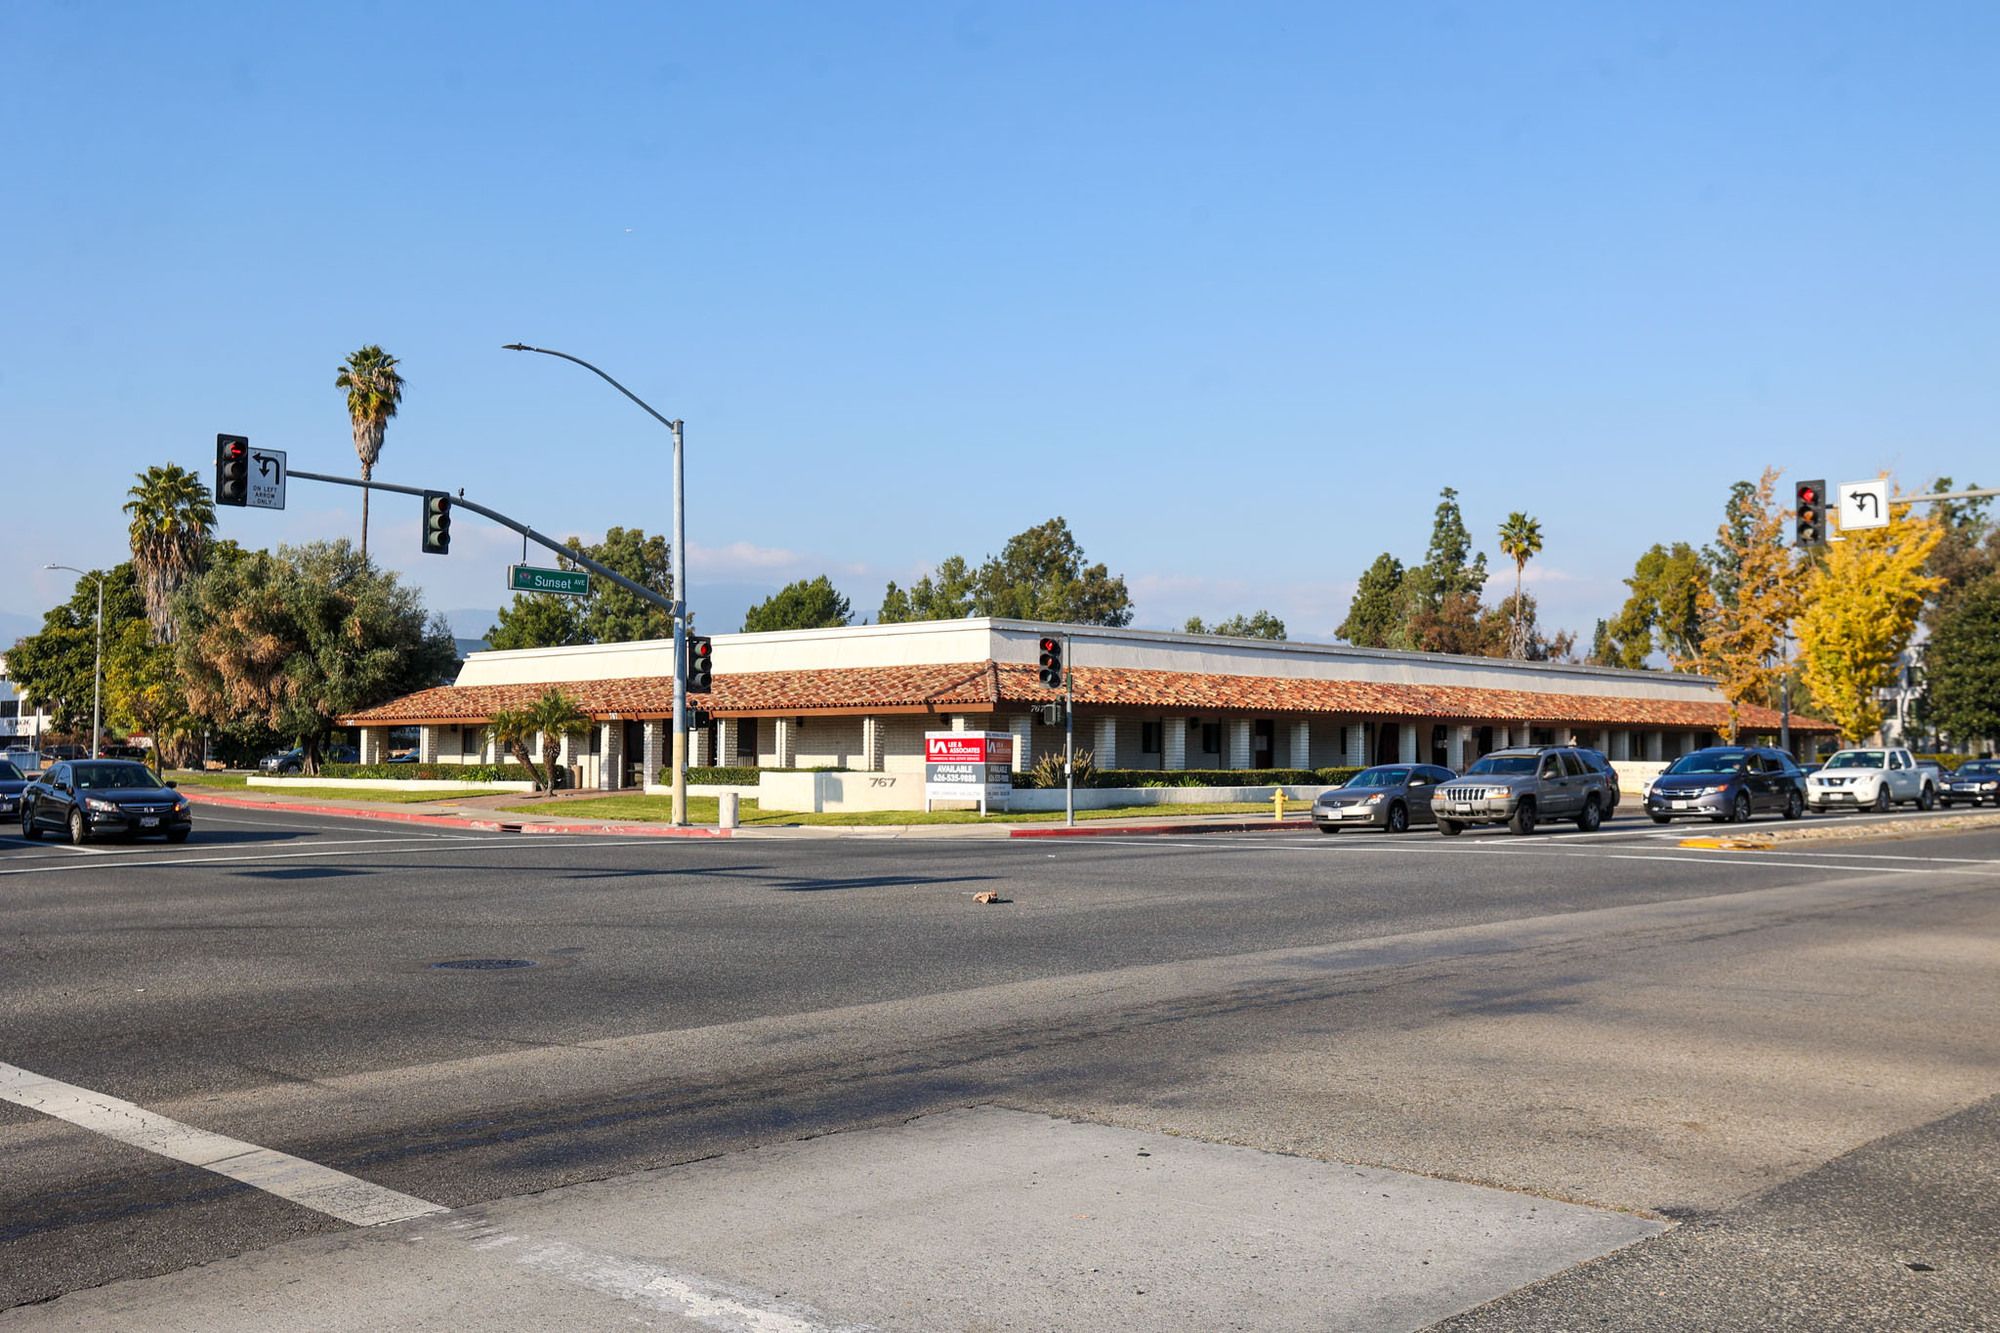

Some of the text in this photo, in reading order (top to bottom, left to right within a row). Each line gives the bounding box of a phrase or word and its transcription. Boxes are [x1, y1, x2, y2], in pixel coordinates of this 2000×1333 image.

[535, 575, 571, 589] Sunset
[869, 777, 897, 788] 767
[933, 774, 976, 782] 626-535-9888
